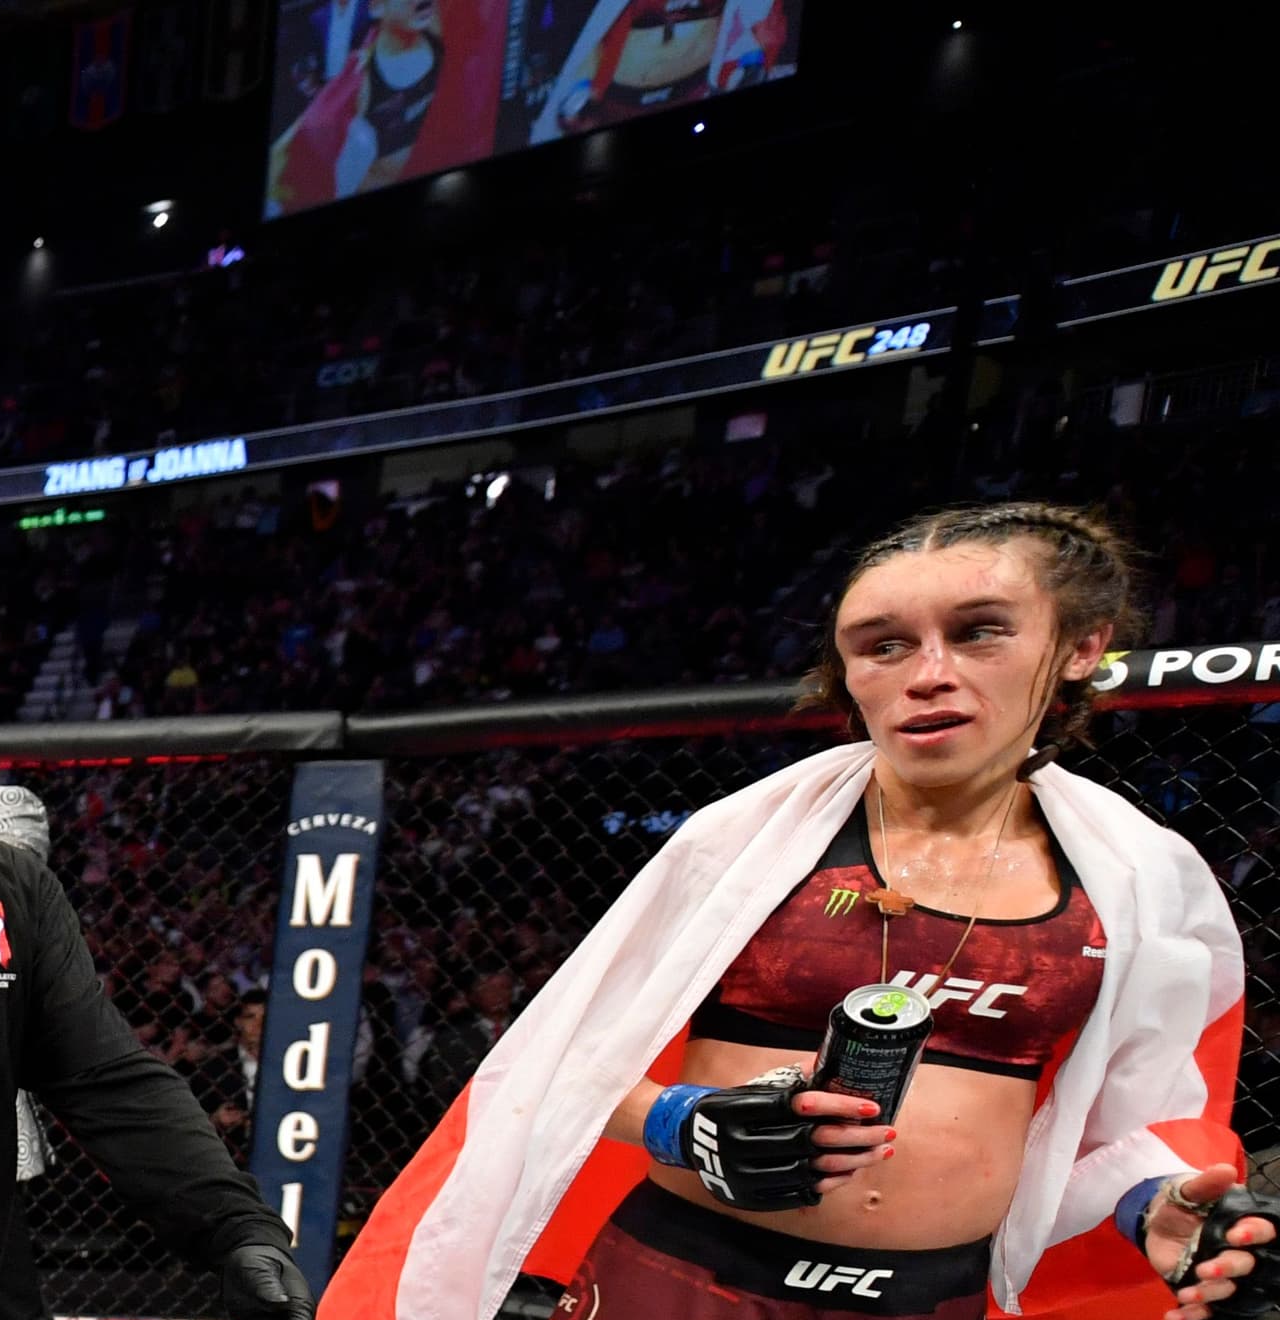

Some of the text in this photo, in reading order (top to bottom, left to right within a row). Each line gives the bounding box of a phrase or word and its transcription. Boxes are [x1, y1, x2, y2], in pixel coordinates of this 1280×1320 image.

[1152, 239, 1280, 301] UFC
[761, 322, 930, 380] UFC 248
[44, 456, 126, 496] ZHANG
[147, 437, 247, 483] JOANNA
[287, 813, 377, 836] CERVEZA
[693, 1112, 735, 1200] UFC
[784, 1260, 894, 1298] UFC
